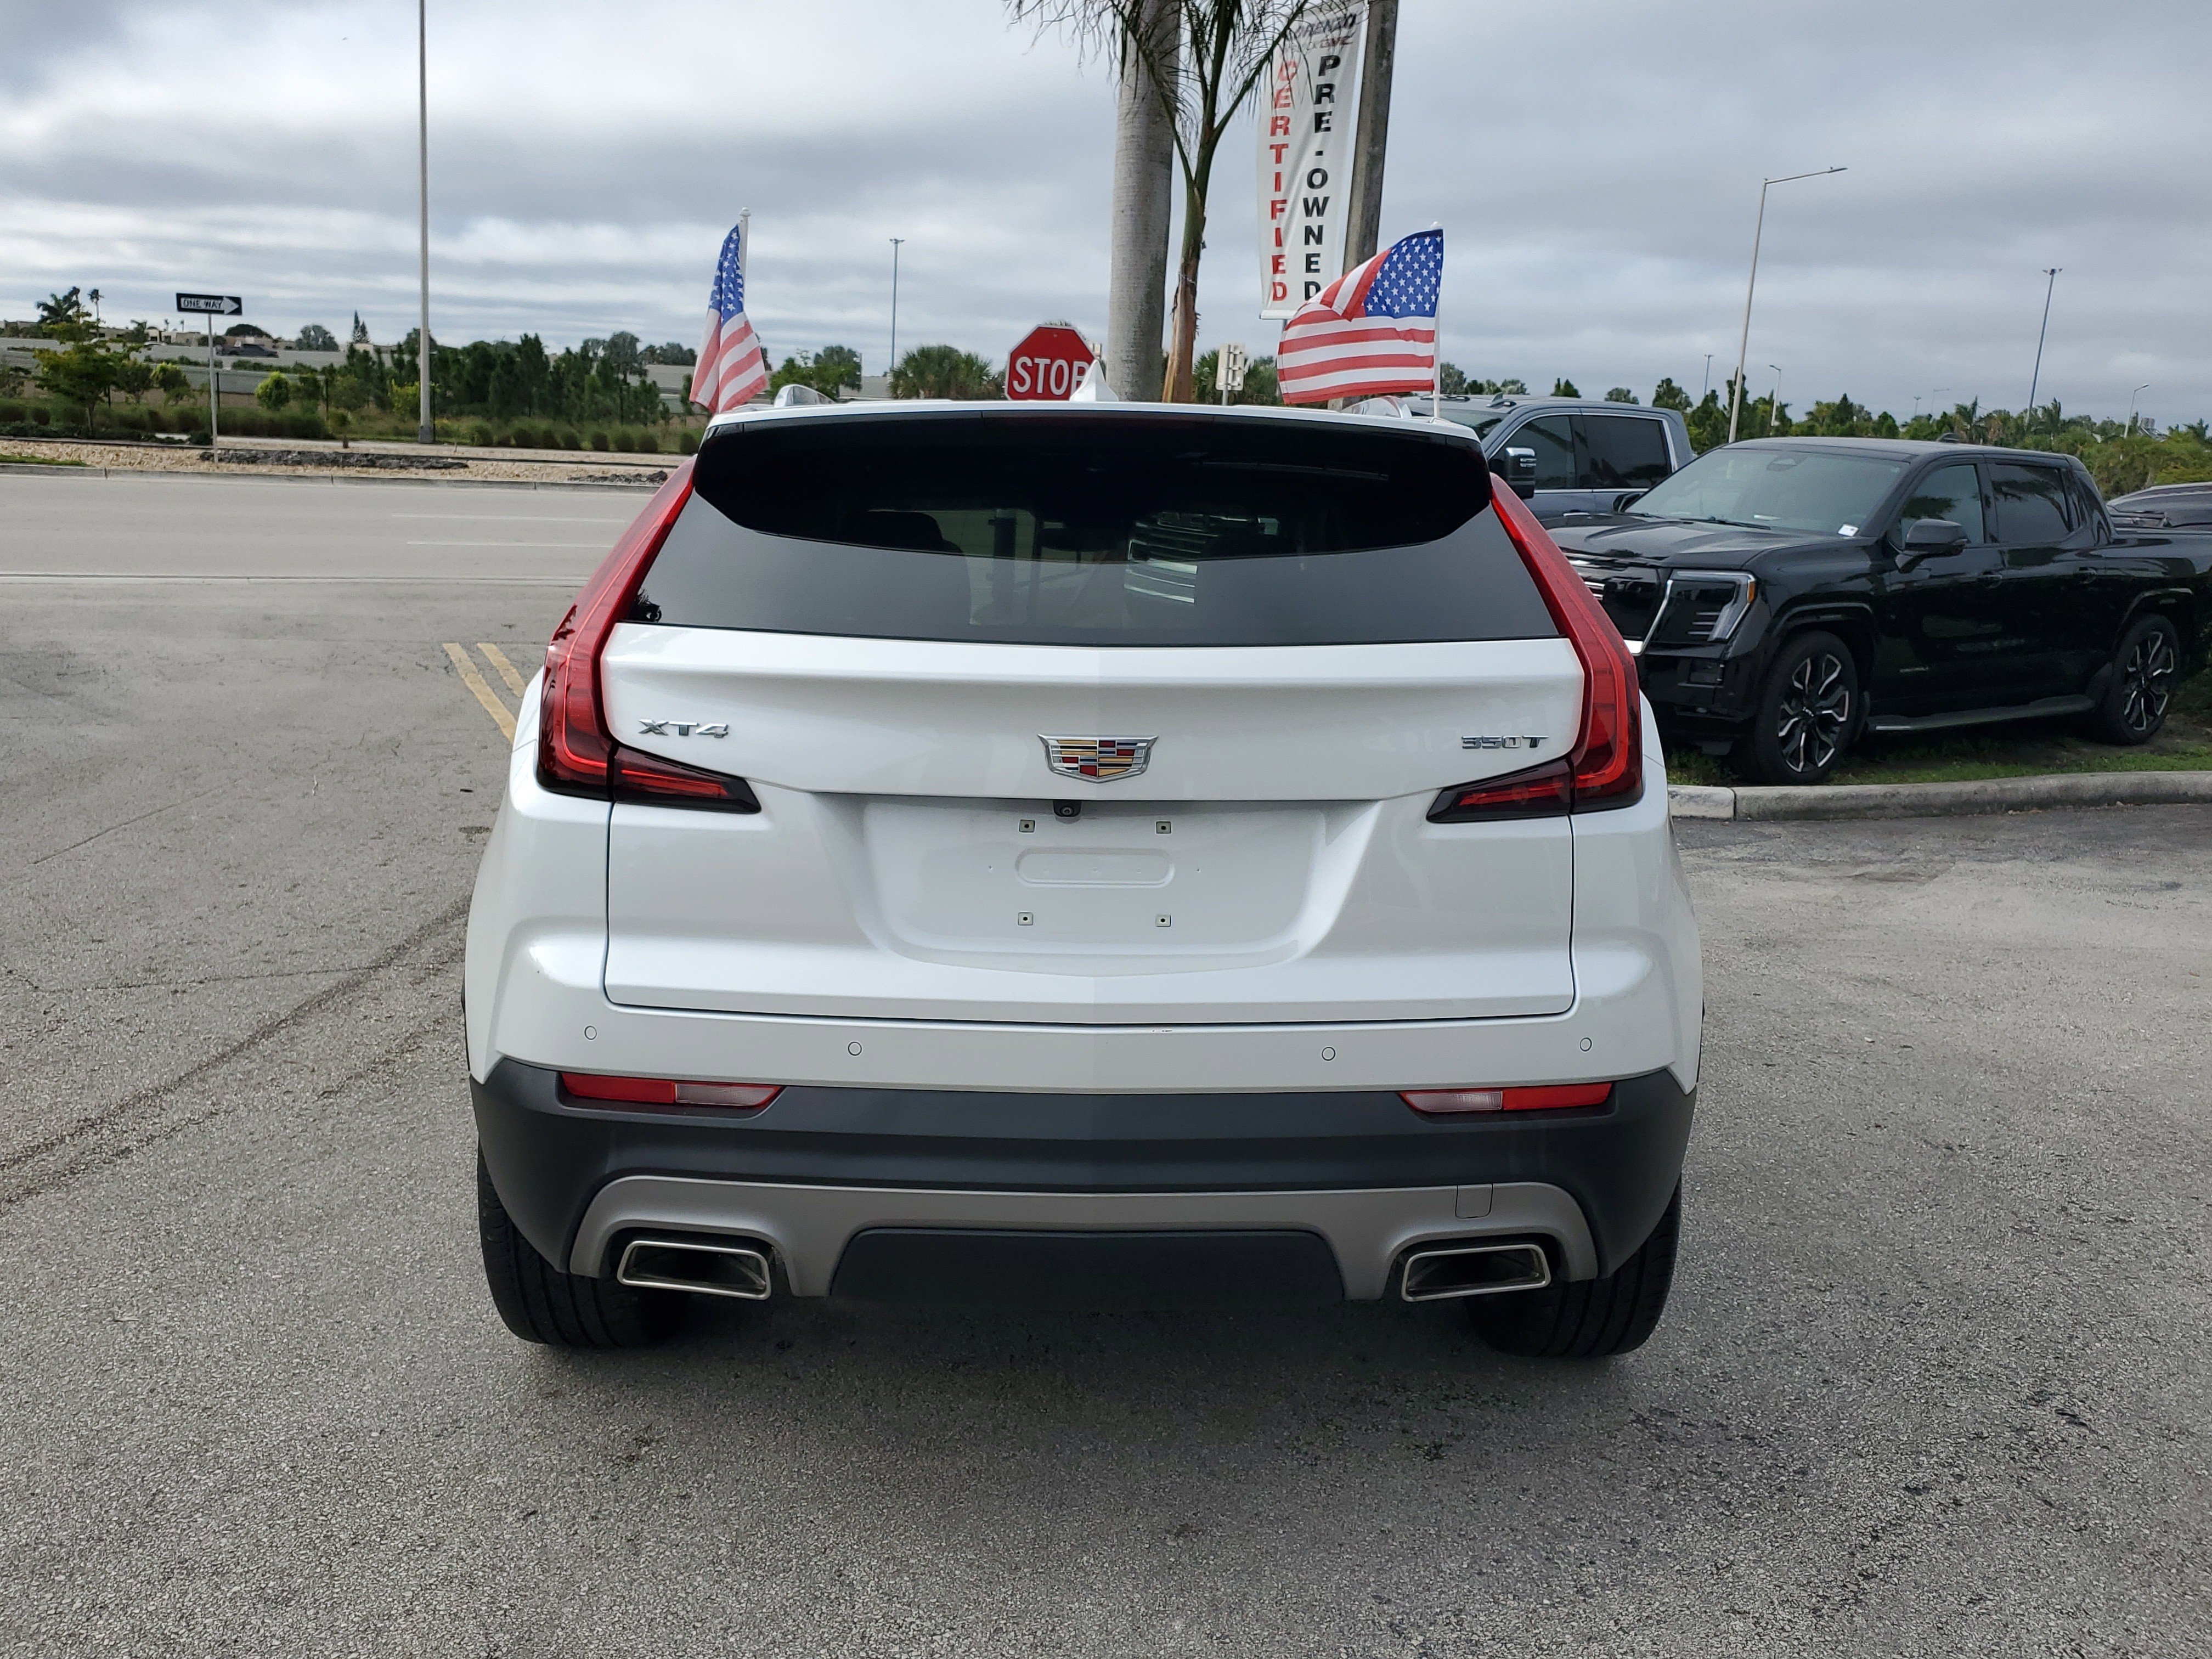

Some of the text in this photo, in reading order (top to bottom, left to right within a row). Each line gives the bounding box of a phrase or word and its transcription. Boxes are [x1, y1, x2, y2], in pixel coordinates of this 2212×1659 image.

[1269, 60, 1297, 302] CERTIFIED
[1302, 55, 1341, 301] PRE-OWNED
[183, 297, 222, 309] ONE WAY
[1013, 356, 1091, 396] STOP
[638, 719, 729, 738] XT4
